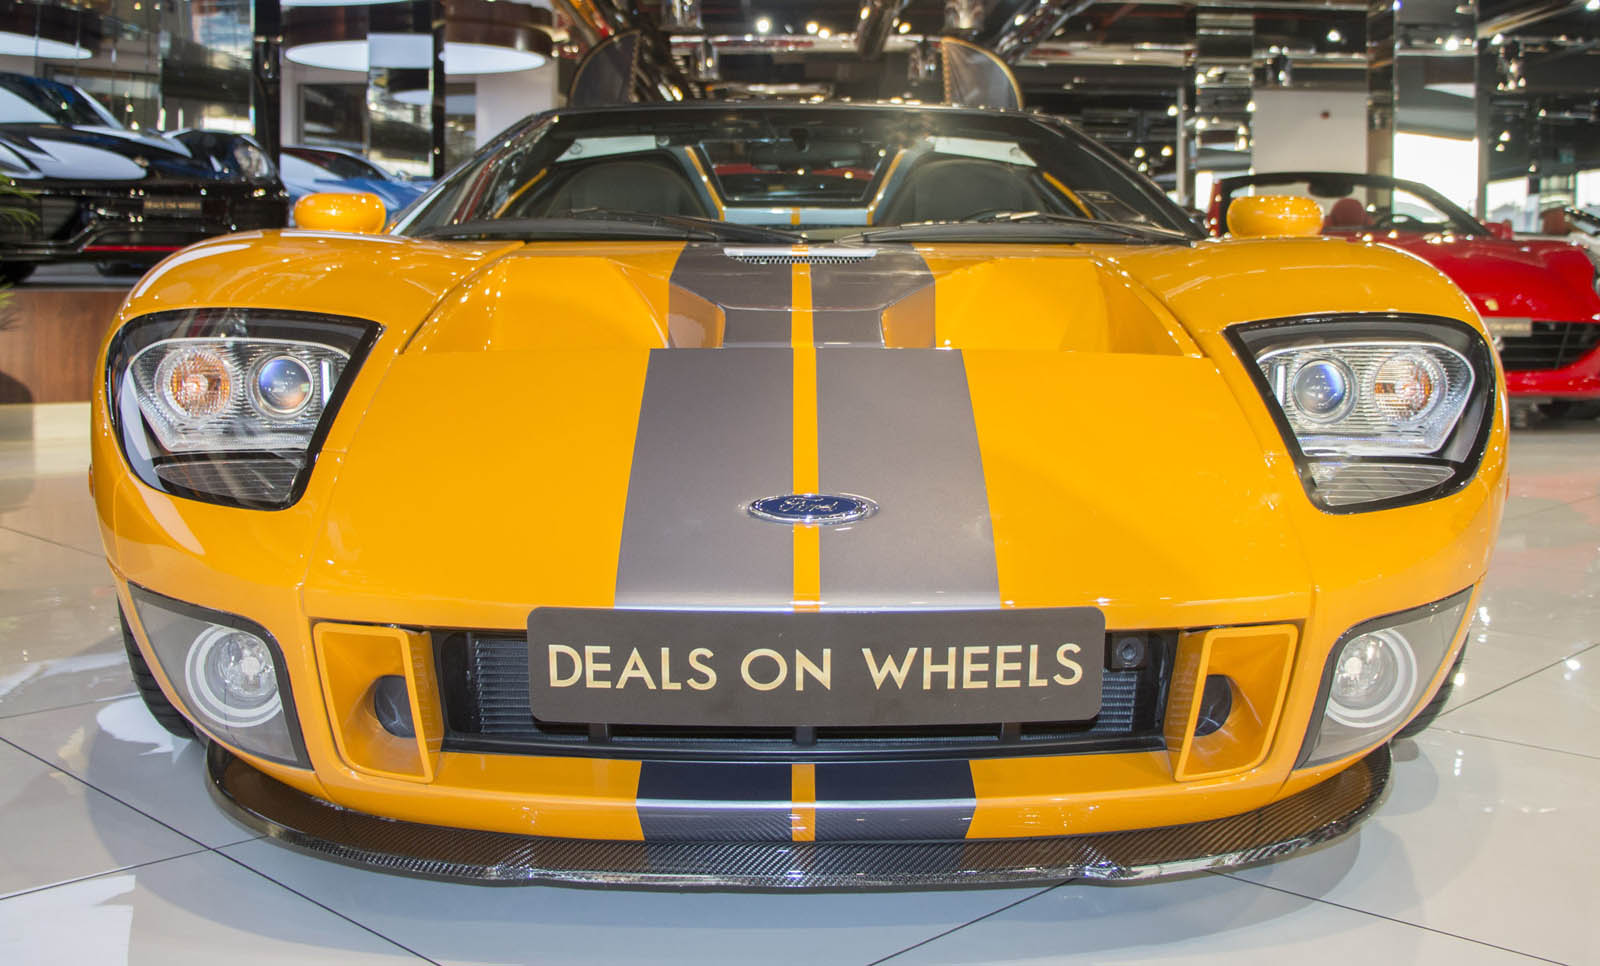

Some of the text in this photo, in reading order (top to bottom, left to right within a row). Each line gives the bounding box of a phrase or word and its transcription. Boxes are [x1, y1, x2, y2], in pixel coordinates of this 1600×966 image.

[778, 497, 838, 513] Ford
[548, 643, 1084, 691] DEALS ON WHEELS
